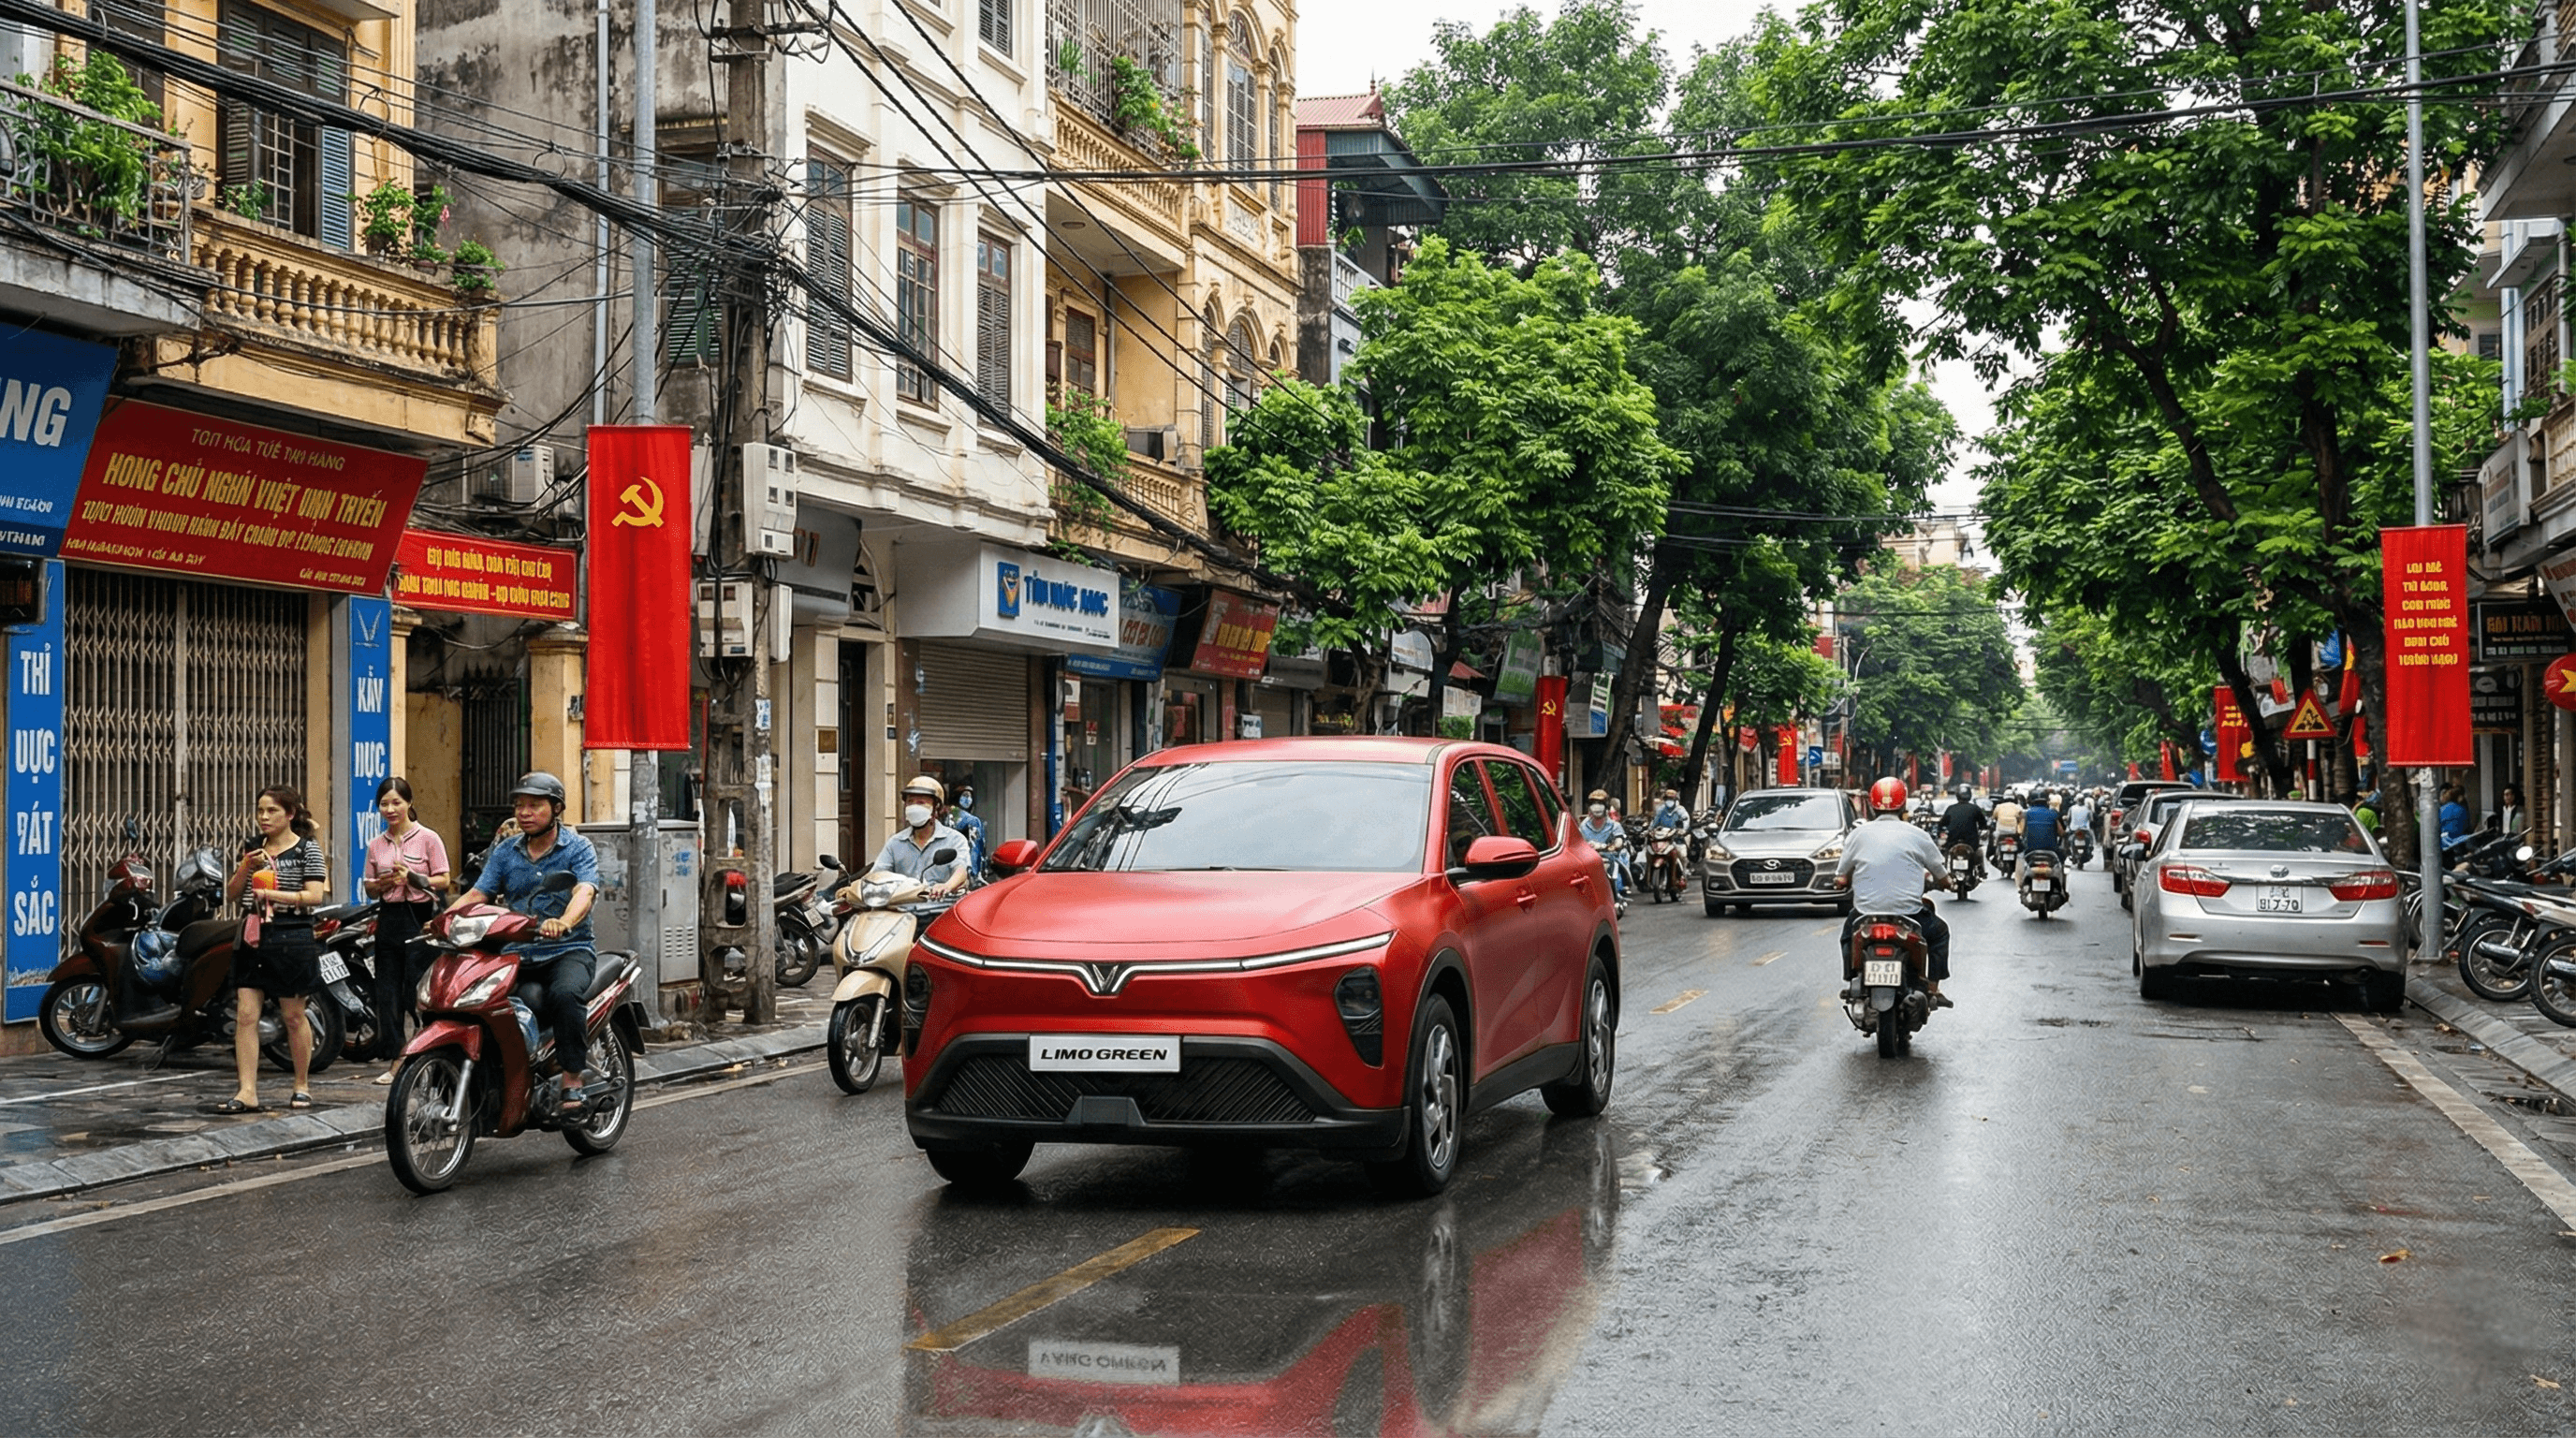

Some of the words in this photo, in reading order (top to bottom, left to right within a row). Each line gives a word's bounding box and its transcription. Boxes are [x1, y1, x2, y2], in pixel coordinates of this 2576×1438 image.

[14, 874, 55, 936] SẮC
[1040, 1049, 1093, 1061] LIMO
[1095, 1049, 1168, 1061] GREEN
